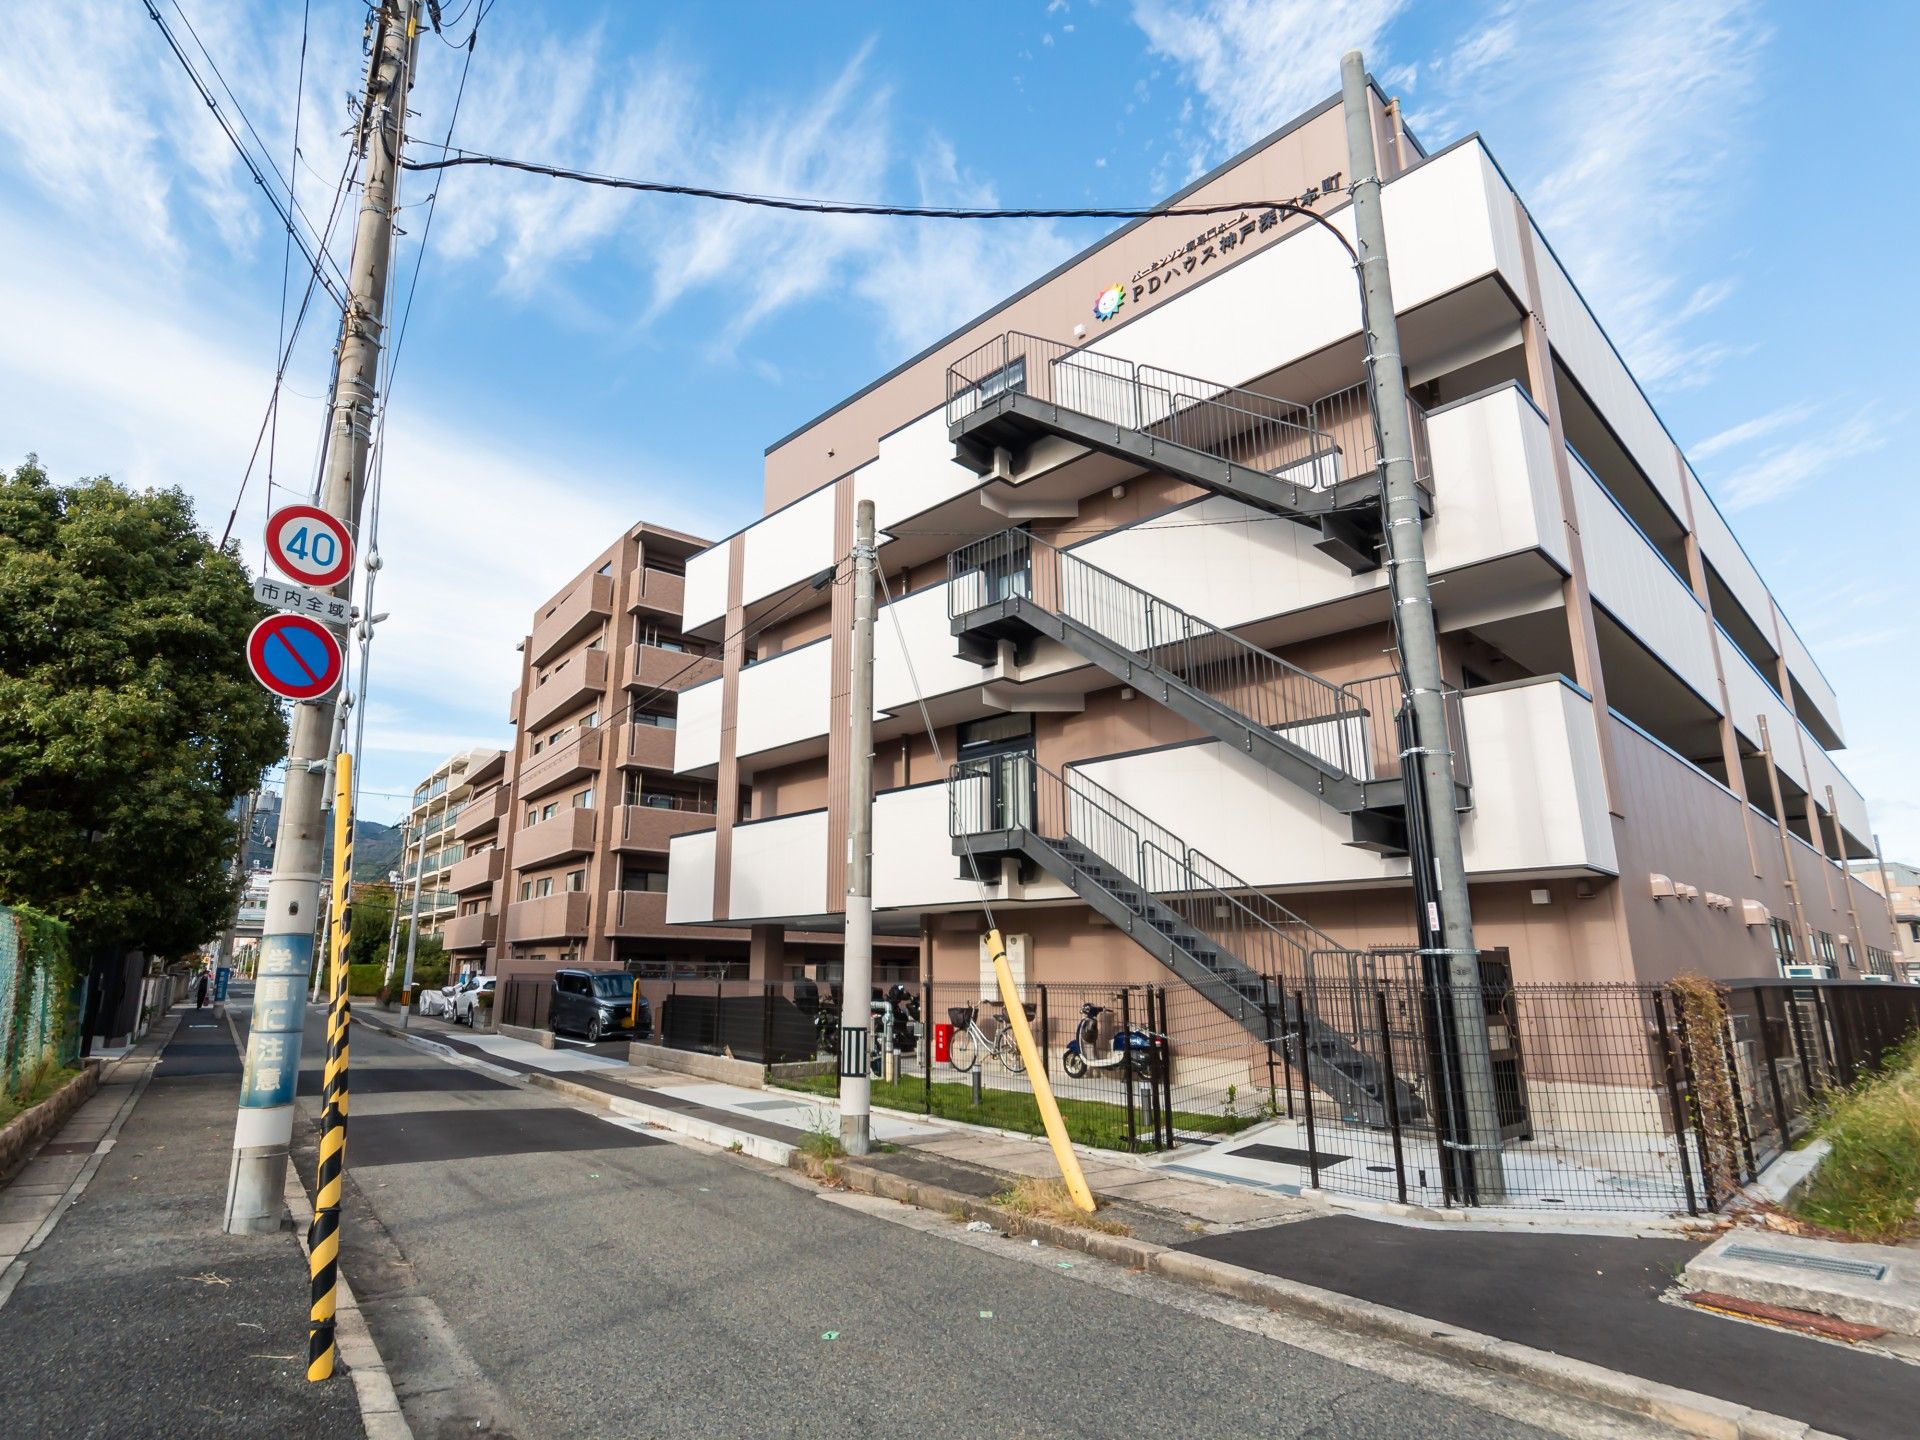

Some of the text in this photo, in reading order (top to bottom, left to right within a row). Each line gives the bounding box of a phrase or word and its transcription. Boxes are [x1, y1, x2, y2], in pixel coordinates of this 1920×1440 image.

[286, 526, 335, 567] 40
[261, 583, 344, 618] 市内全域
[255, 948, 292, 1091] 学童に注意
